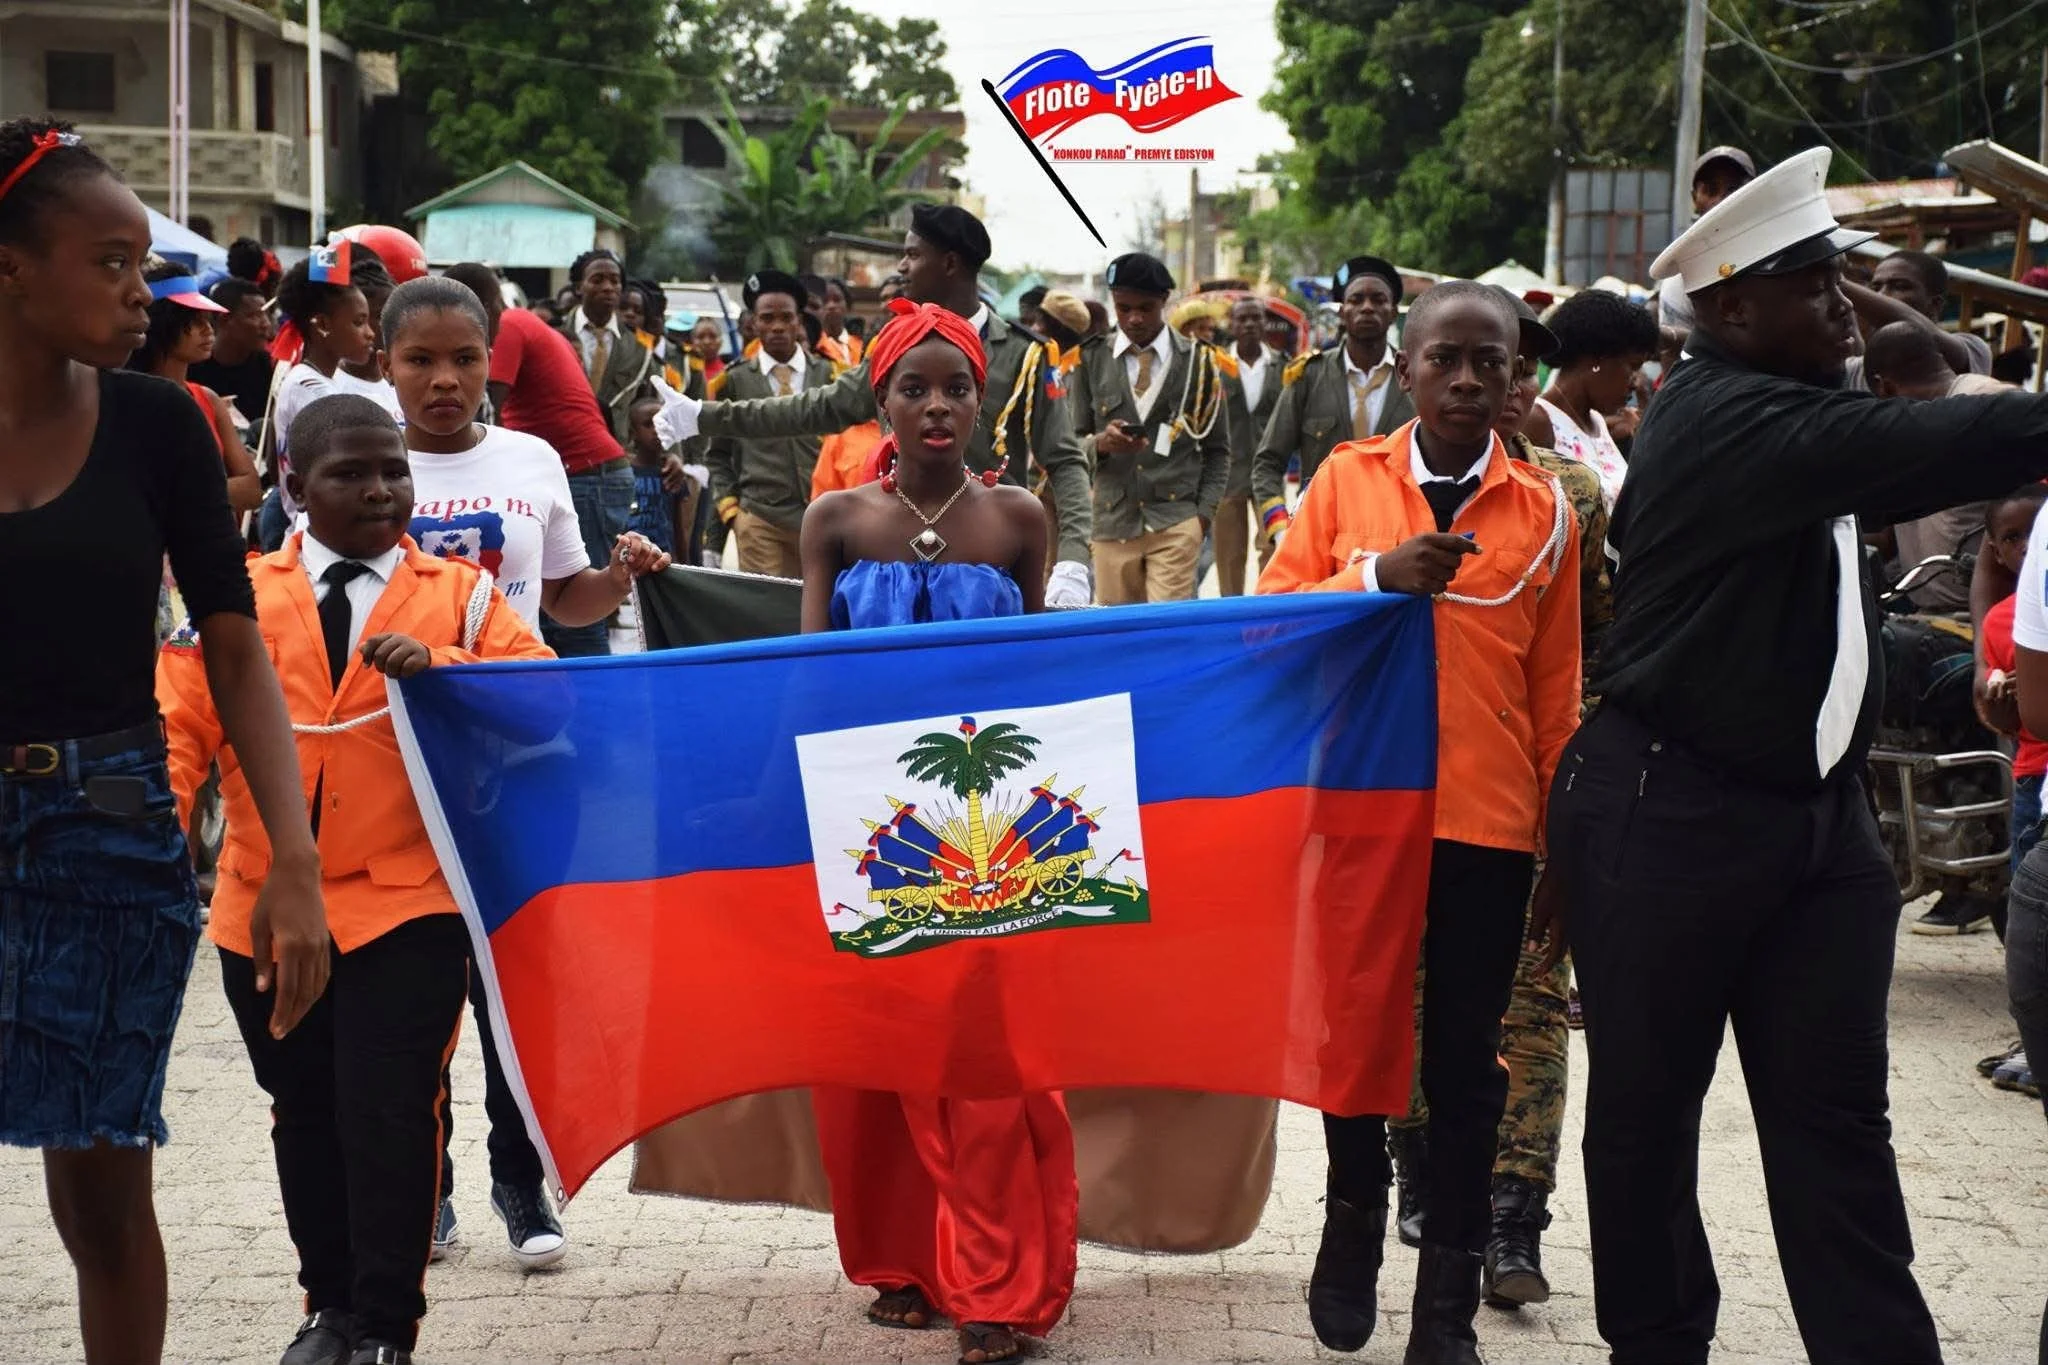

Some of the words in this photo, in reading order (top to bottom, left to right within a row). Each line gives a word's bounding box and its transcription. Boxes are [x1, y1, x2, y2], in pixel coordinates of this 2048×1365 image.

[507, 498, 533, 516] m
[1003, 921, 1018, 932] LA
[1020, 907, 1063, 928] FORCE
